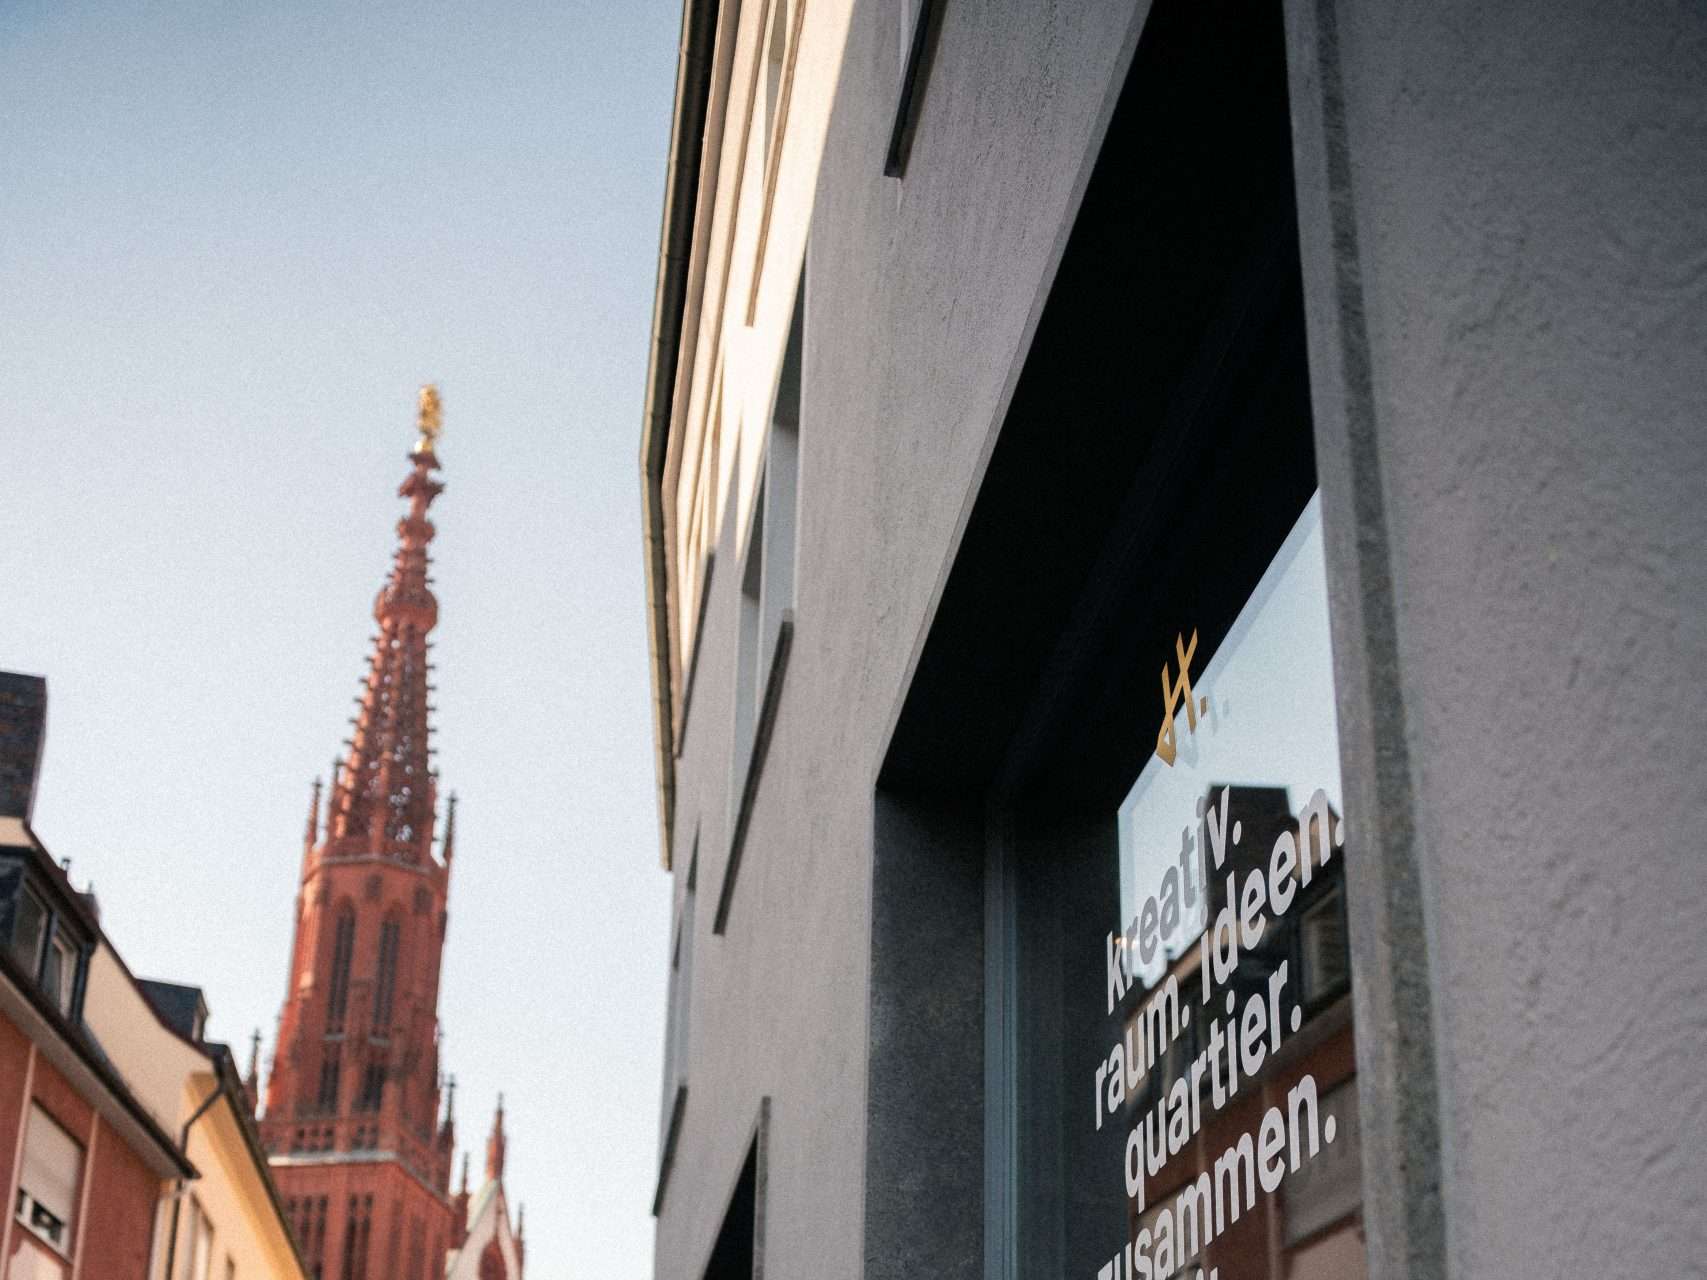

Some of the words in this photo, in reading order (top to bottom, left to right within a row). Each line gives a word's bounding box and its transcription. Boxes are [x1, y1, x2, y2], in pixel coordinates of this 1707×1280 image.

[1106, 785, 1242, 1016] kreativ.
[1095, 974, 1190, 1131] raum.
[1125, 959, 1302, 1214] quartier.
